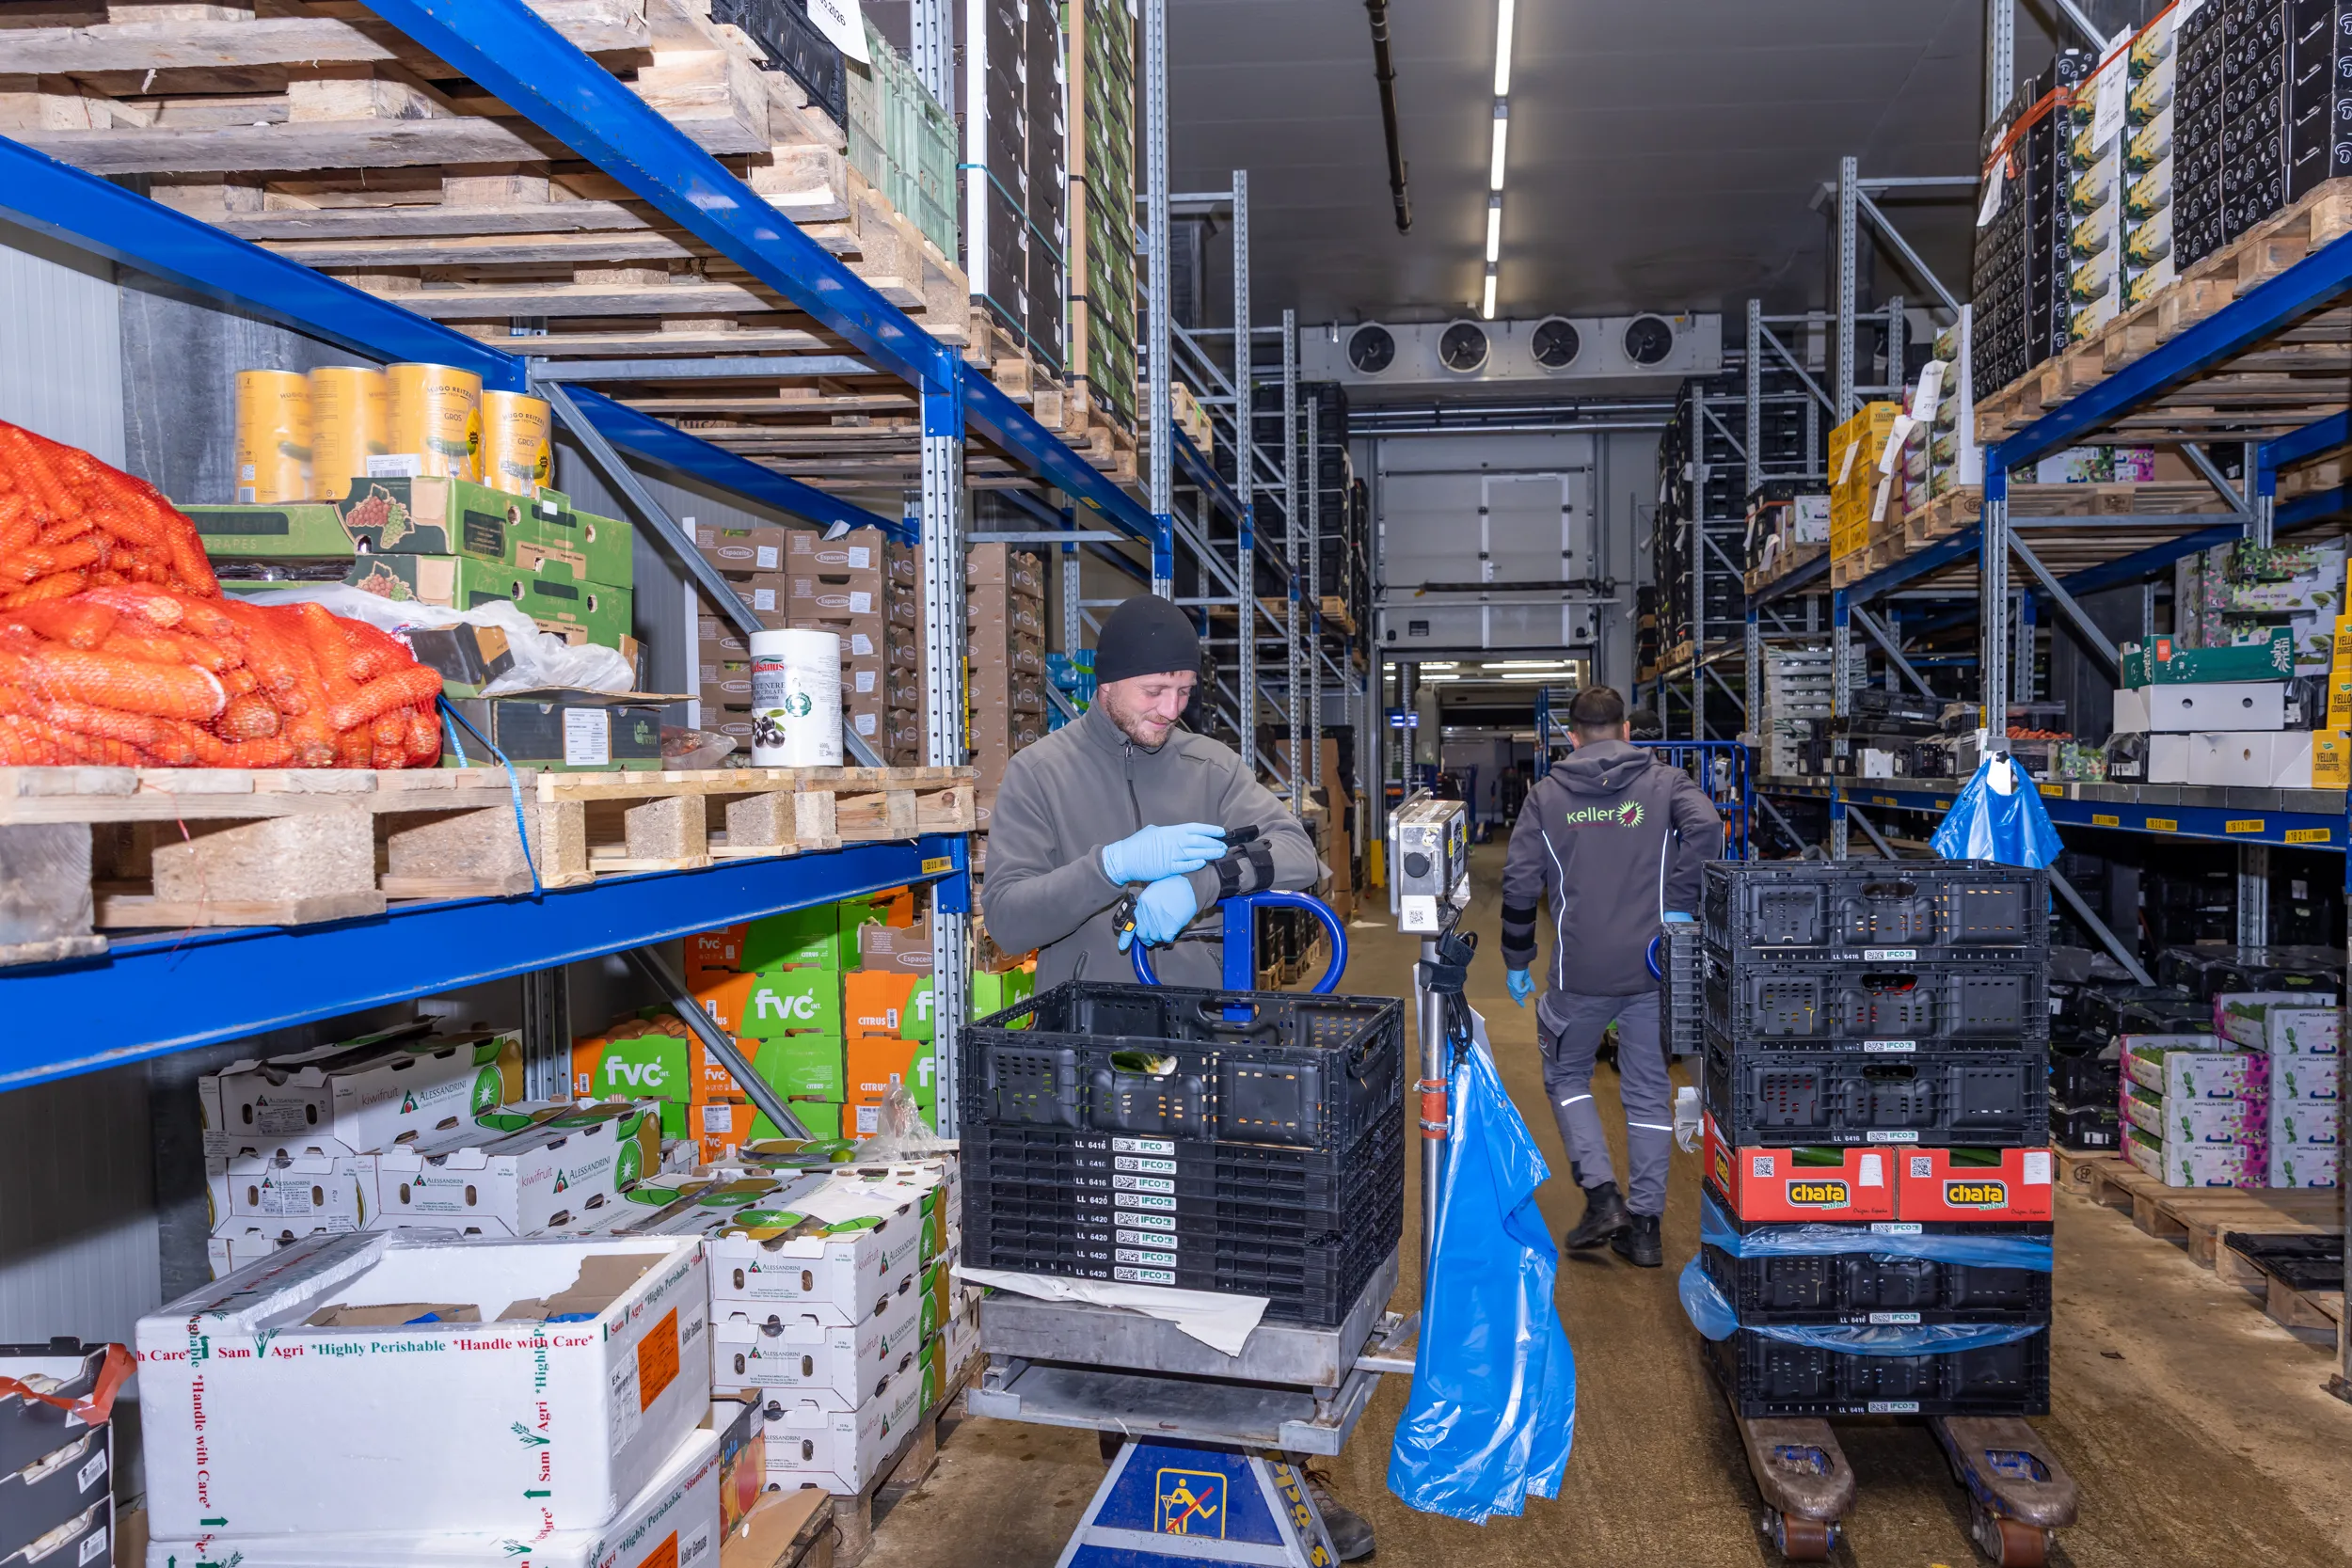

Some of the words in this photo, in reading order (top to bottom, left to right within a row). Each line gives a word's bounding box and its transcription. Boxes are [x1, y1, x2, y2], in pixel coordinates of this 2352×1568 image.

[444, 412, 463, 421] GROS
[203, 538, 257, 549] GRAPES
[723, 548, 750, 557] Espaceite
[819, 554, 848, 562] Espaceite
[820, 597, 849, 606] Espaceite
[2338, 636, 2352, 647] YELL
[2336, 647, 2351, 656] COURGE
[2333, 693, 2351, 705] YELLO
[2331, 704, 2351, 713] COURGET
[2316, 752, 2339, 763] YELLOW
[2314, 763, 2340, 771] COURGETTES
[1566, 806, 1615, 824] keller
[903, 955, 932, 964] Espaceit
[755, 988, 815, 1020] fvc
[857, 1017, 886, 1026] CITRUS
[605, 1055, 663, 1087] fvc
[860, 1083, 888, 1091] CITRUS
[361, 1087, 399, 1106] kiwifruit
[419, 1080, 467, 1102] ALESSANDRINI
[1075, 1140, 1084, 1148] LL
[1088, 1141, 1106, 1149] 6416
[1140, 1142, 1162, 1150] IFCO
[1075, 1159, 1085, 1167] LL
[1141, 1160, 1164, 1169] IFCO
[521, 1166, 553, 1188] kiwifruit
[569, 1155, 611, 1180] ALESSANDRINI
[1139, 1179, 1161, 1188] IFCO
[1791, 1184, 1845, 1201] chata
[1948, 1185, 2003, 1202] chata
[1076, 1195, 1086, 1203] LL
[1089, 1196, 1108, 1205] 6420
[1141, 1196, 1164, 1206] IFCO
[1140, 1215, 1163, 1225] IFCO
[1090, 1233, 1108, 1242] 6420
[1142, 1234, 1164, 1243] IFCO
[858, 1247, 880, 1272] kiwifruit
[889, 1233, 917, 1262] ALESSANDRINI
[1089, 1251, 1108, 1259] 6420
[1141, 1252, 1164, 1261] IFCO
[1140, 1271, 1162, 1279] IFCO
[611, 1320, 625, 1337] Sam
[630, 1302, 644, 1321] Agri
[857, 1335, 880, 1360] kiwifruit
[889, 1313, 916, 1343] ALESSANDRINI
[218, 1347, 251, 1359] Sam
[271, 1344, 305, 1360] Agri
[371, 1339, 447, 1354] Perishable
[517, 1336, 548, 1349] with
[536, 1402, 551, 1433] Agri
[859, 1413, 881, 1441] kiwifruit
[889, 1387, 918, 1422] ALESSANDRINI
[196, 1435, 210, 1466] with
[538, 1451, 550, 1481] Sam
[647, 1491, 682, 1529] Perishable
[708, 1453, 720, 1470] wit
[680, 1545, 692, 1567] Keller
